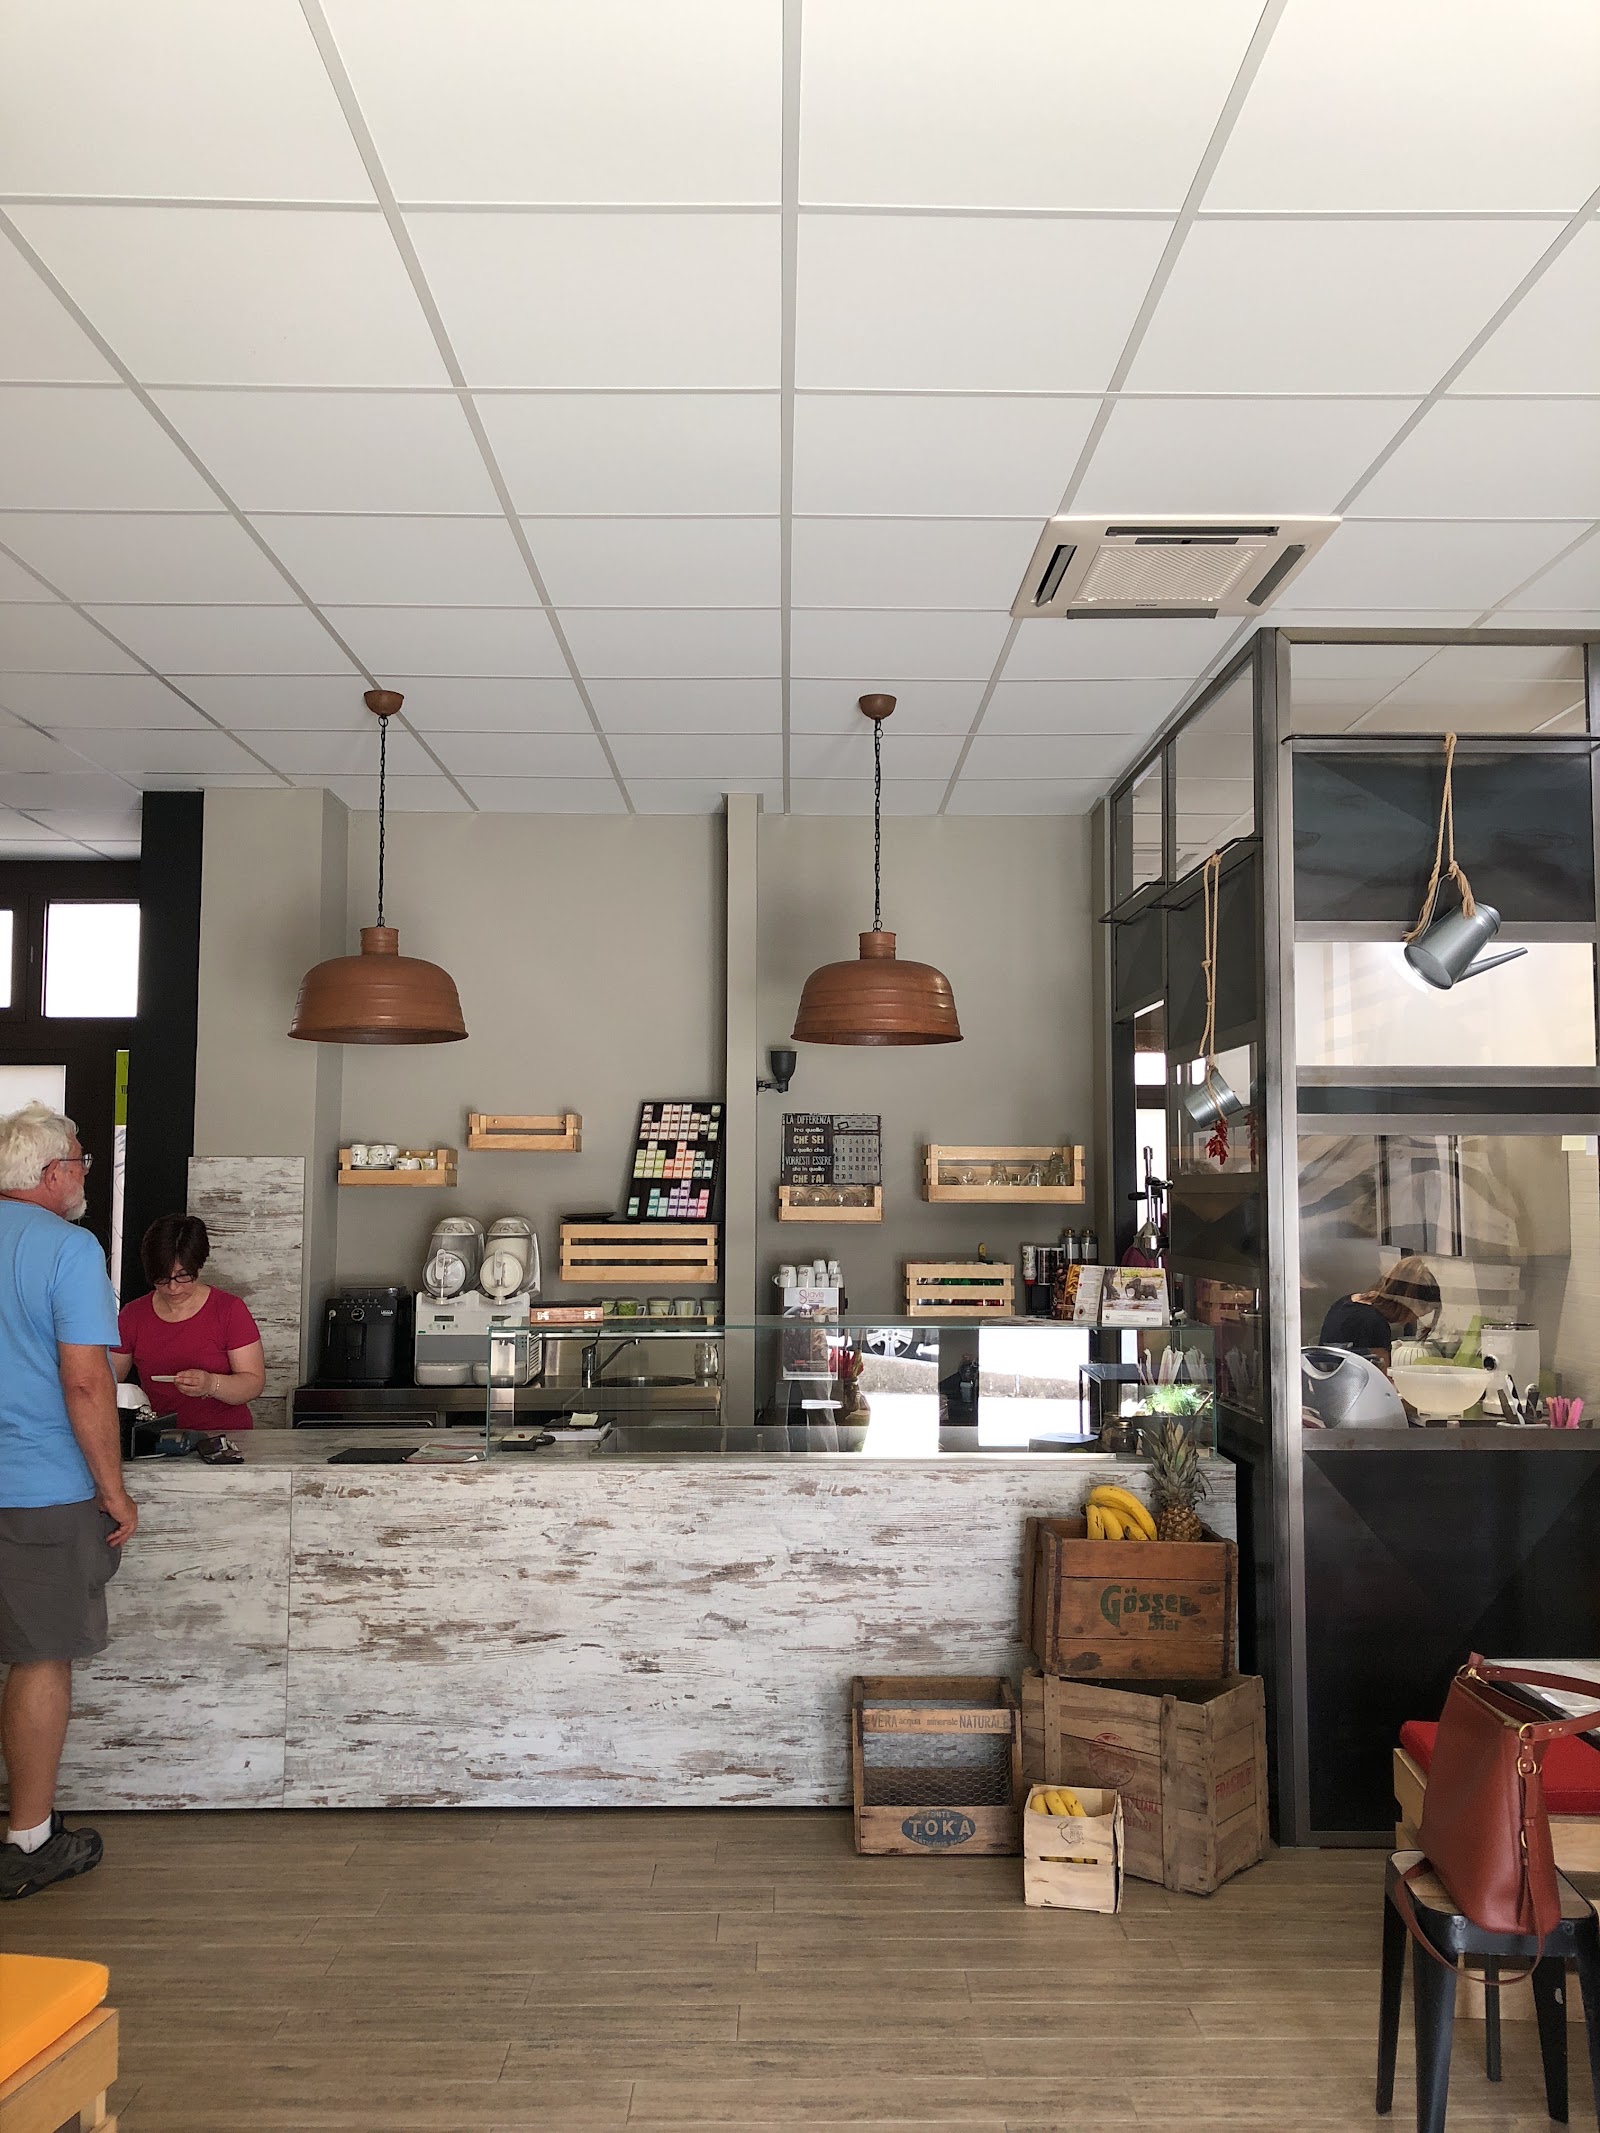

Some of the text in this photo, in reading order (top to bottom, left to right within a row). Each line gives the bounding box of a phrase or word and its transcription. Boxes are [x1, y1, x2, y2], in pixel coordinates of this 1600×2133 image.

[786, 1115, 794, 1124] LA
[797, 1115, 831, 1124] DIFFERENZA
[793, 1135, 824, 1144] CHE SEI
[785, 1156, 832, 1165] VORRESTI ESSERE
[792, 1175, 825, 1183] CHE FAI
[799, 1289, 824, 1305] Suavis
[871, 1714, 898, 1728] VERA
[898, 1718, 921, 1727] acqua
[927, 1717, 958, 1726] minerale
[959, 1715, 1008, 1728] NATURALE
[908, 1820, 972, 1836] TOKA
